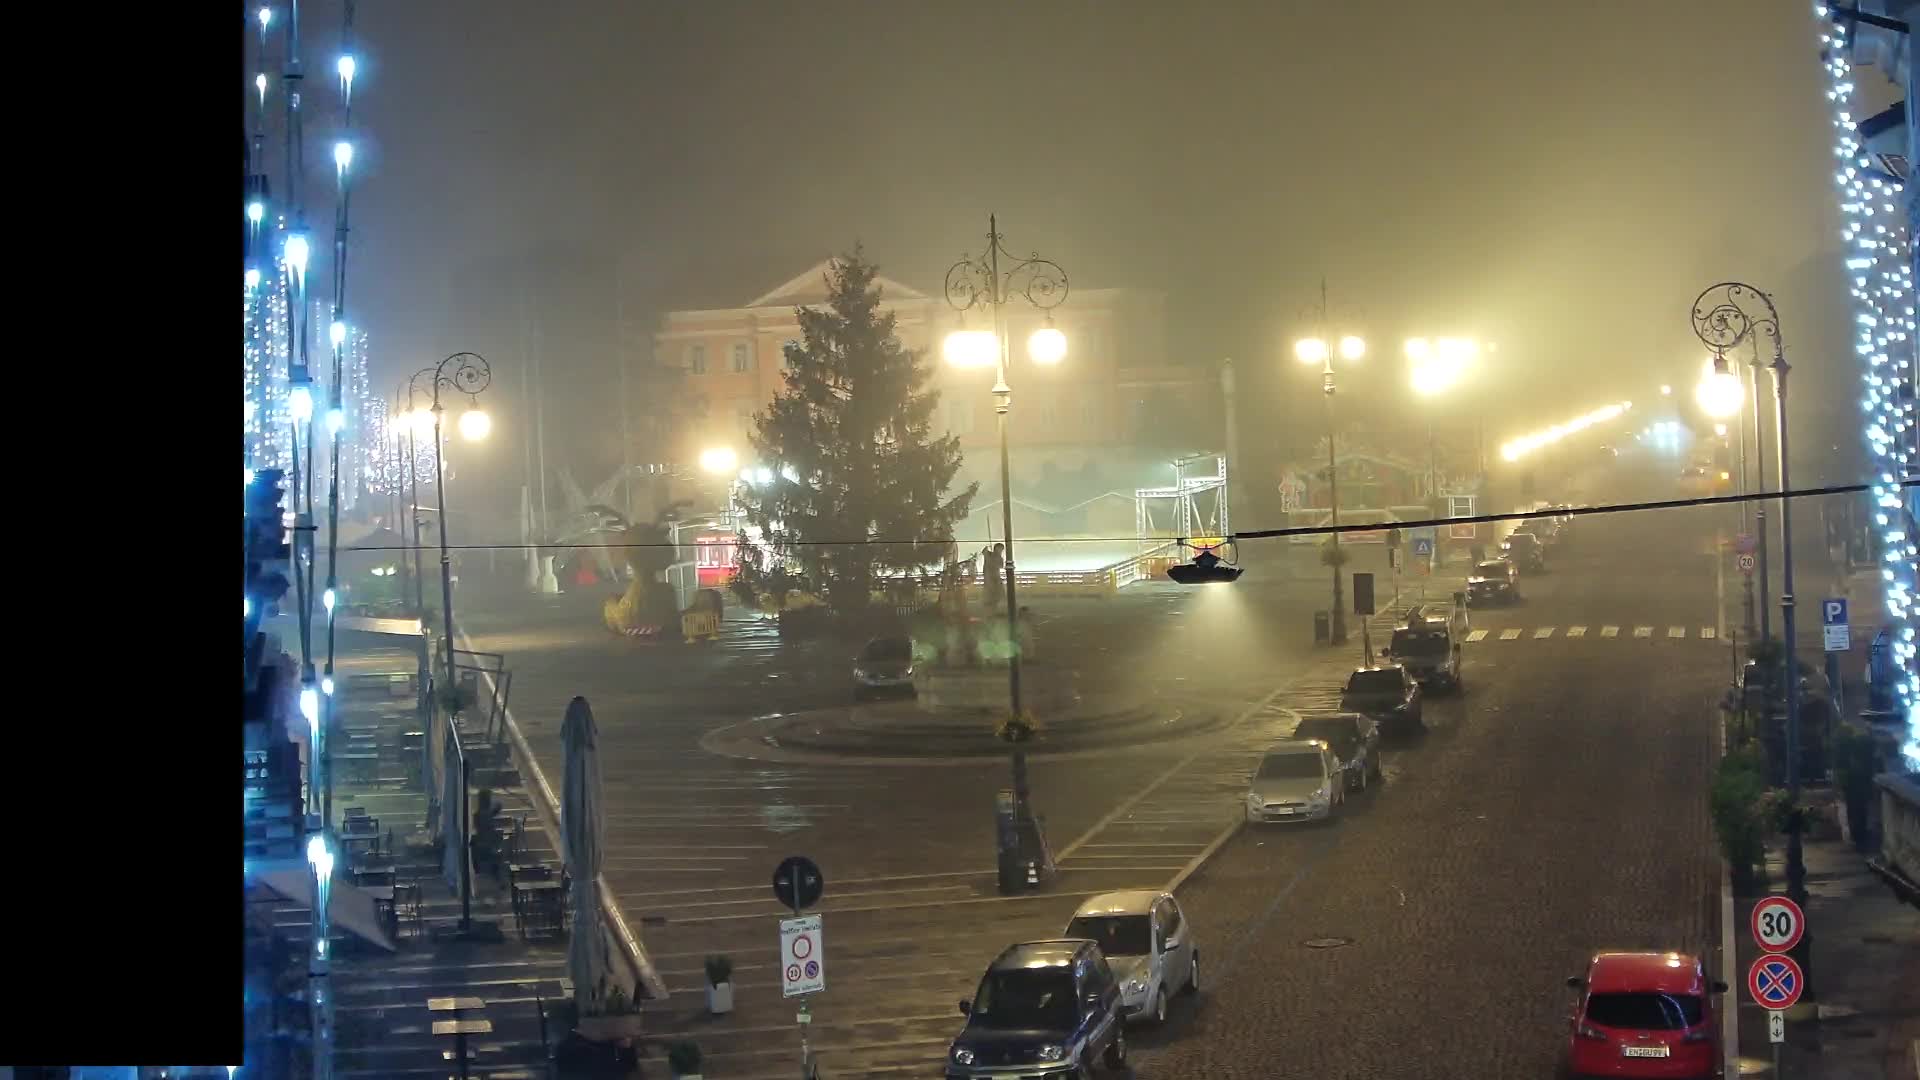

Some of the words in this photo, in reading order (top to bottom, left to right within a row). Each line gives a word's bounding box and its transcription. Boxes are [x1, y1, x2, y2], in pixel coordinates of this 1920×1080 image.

[1742, 557, 1753, 567] 20
[1827, 602, 1842, 621] P
[1762, 911, 1792, 938] 30
